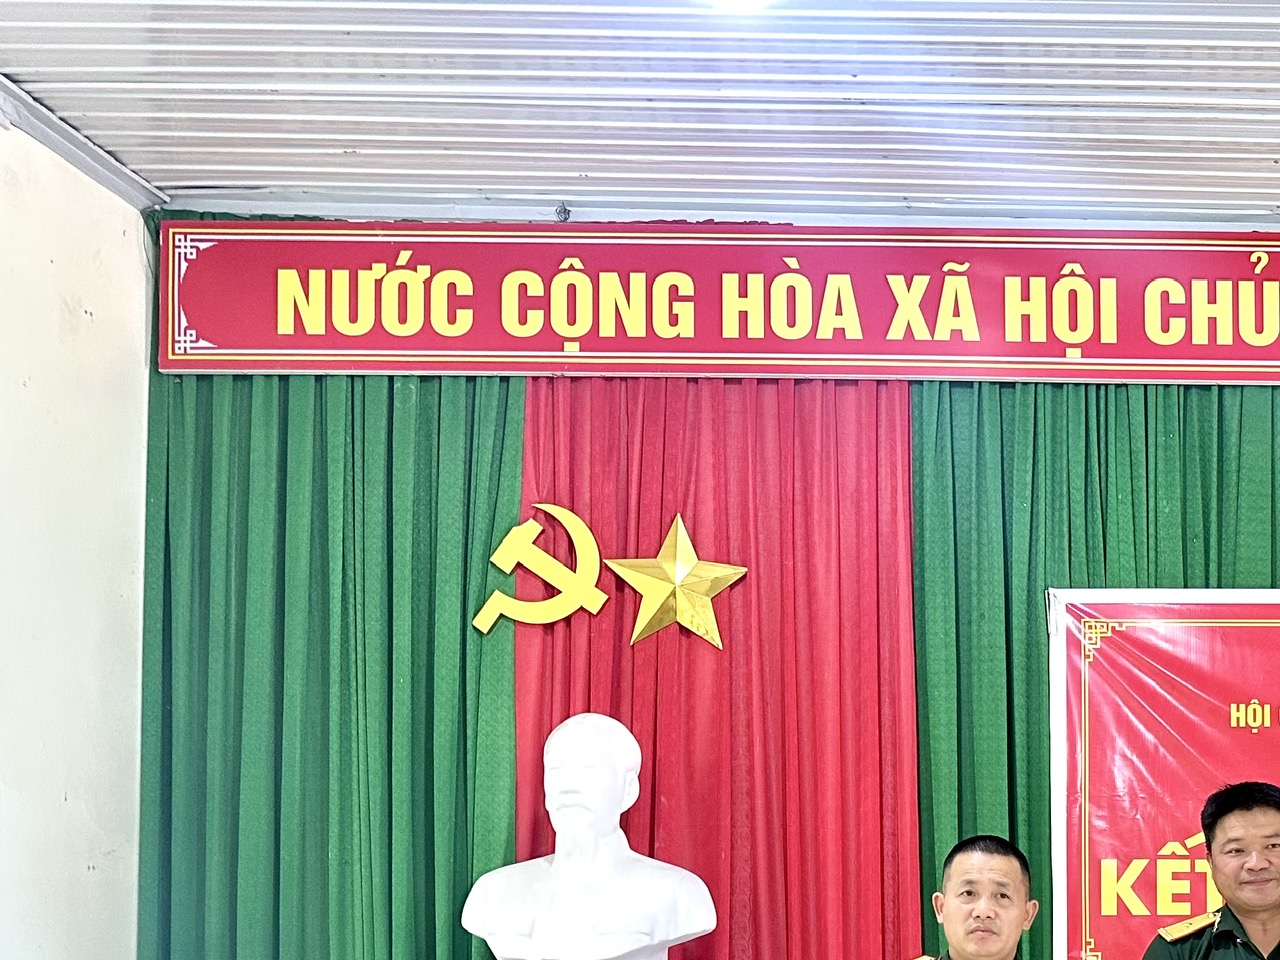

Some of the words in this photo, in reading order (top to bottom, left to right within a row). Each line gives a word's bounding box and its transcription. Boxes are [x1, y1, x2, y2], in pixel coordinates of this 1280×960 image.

[278, 250, 474, 337] NƯỚC
[501, 257, 694, 351] CỘNG
[722, 256, 863, 341] HÒA
[885, 261, 980, 342] XÃ
[1005, 262, 1118, 358] HỘI
[1145, 251, 1280, 346] CHỦ
[1230, 699, 1271, 733] HỘI
